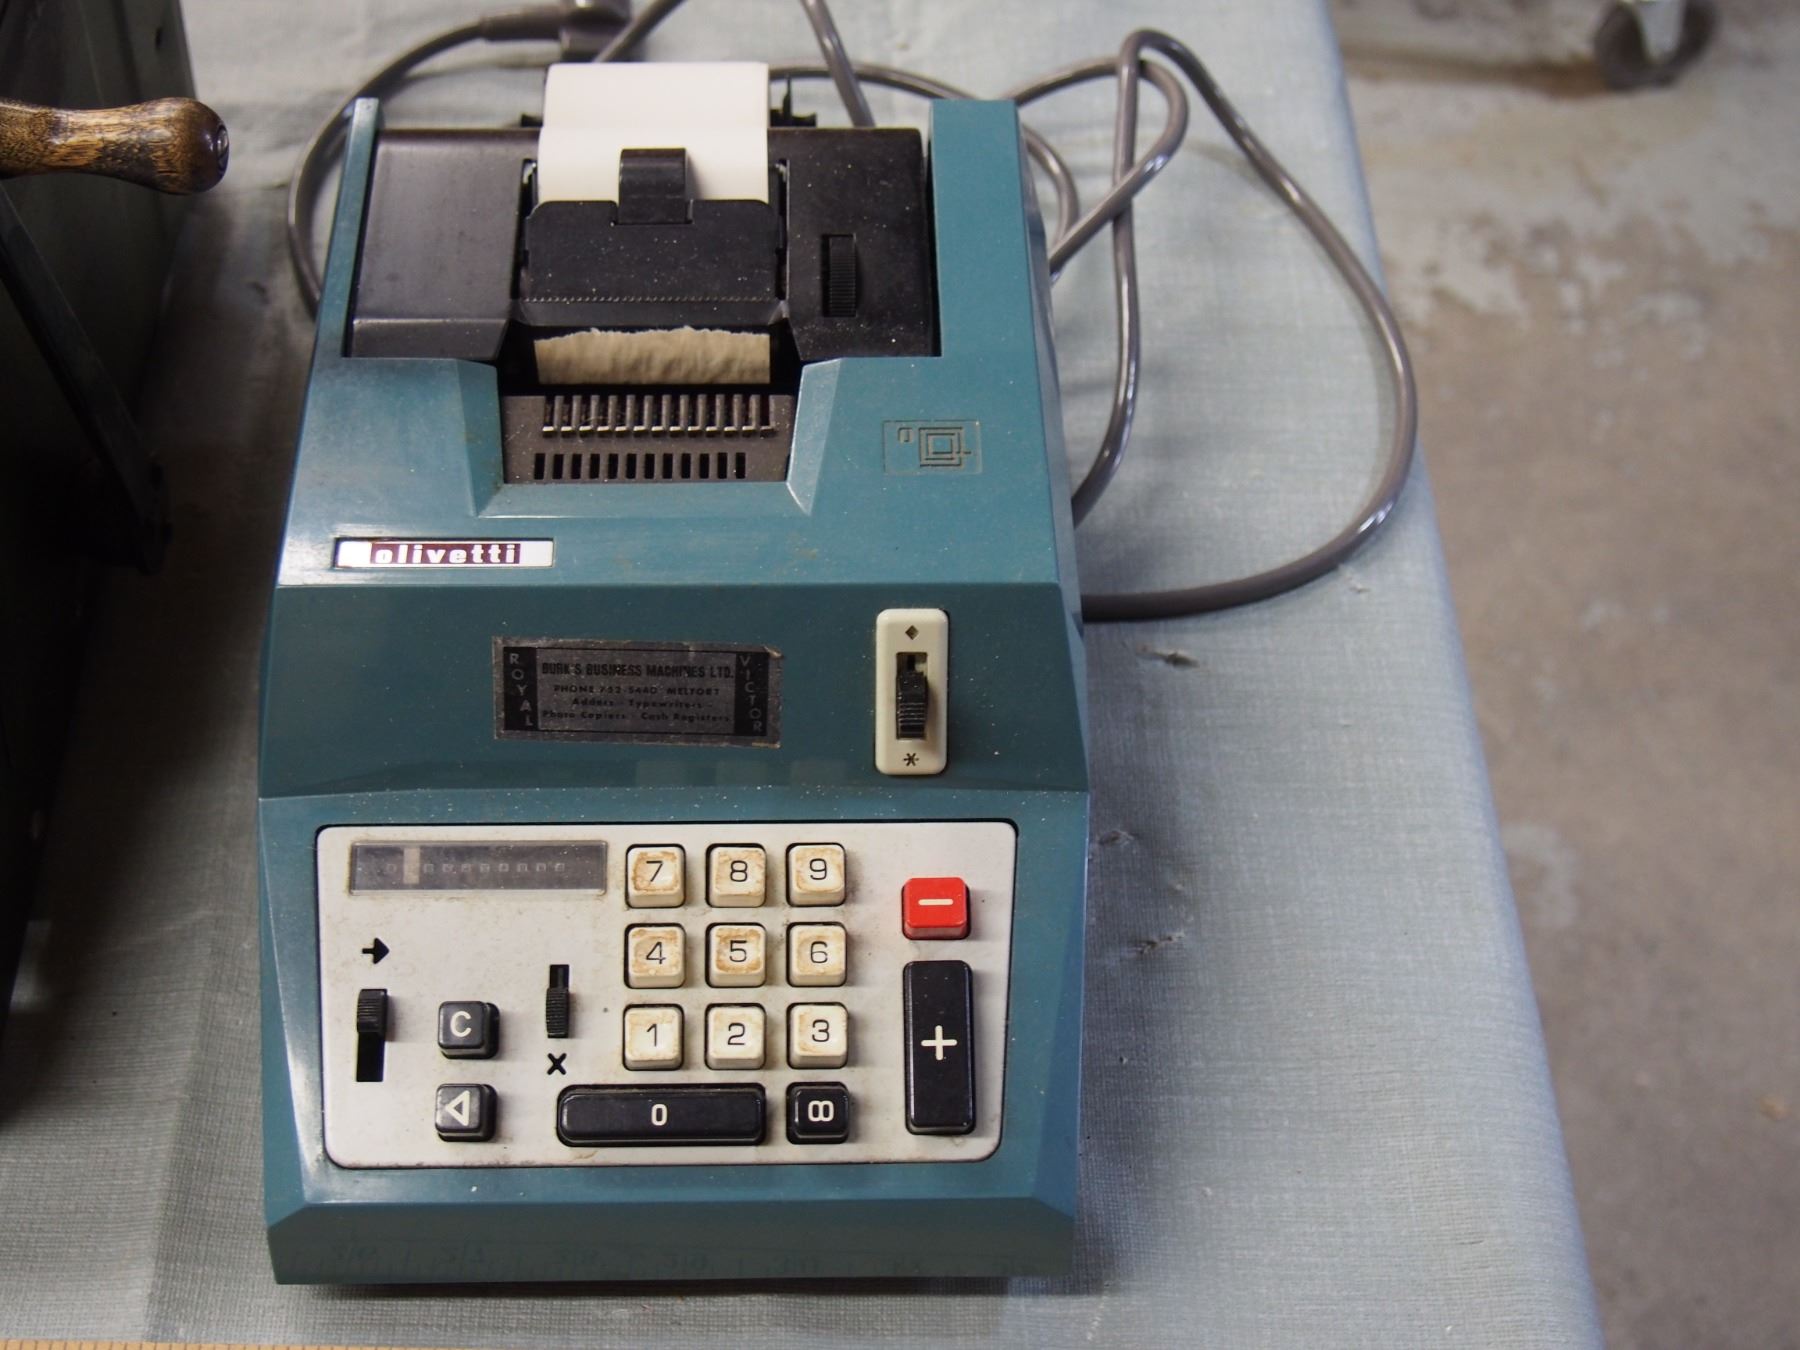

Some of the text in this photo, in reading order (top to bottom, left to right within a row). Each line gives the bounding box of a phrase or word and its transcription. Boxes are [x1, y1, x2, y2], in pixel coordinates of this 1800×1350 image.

[374, 543, 516, 565] olivetti
[586, 663, 642, 677] BUSINESS
[646, 664, 706, 678] MACHINES
[710, 666, 734, 679] LTD.
[508, 652, 534, 727] ROYAL
[553, 684, 595, 694] PHONE
[738, 655, 763, 732] VICTOR
[542, 709, 576, 720] Photo
[640, 711, 669, 721] Cash
[646, 860, 664, 882] 7
[729, 860, 748, 883] 8
[809, 858, 828, 881] 9
[645, 941, 665, 965] 4
[729, 939, 748, 964] 5
[810, 940, 828, 964] 6
[449, 1010, 472, 1038] C
[646, 1022, 657, 1046] 1
[727, 1022, 746, 1046] 2
[812, 1019, 830, 1043] 3
[651, 1103, 668, 1126] 0
